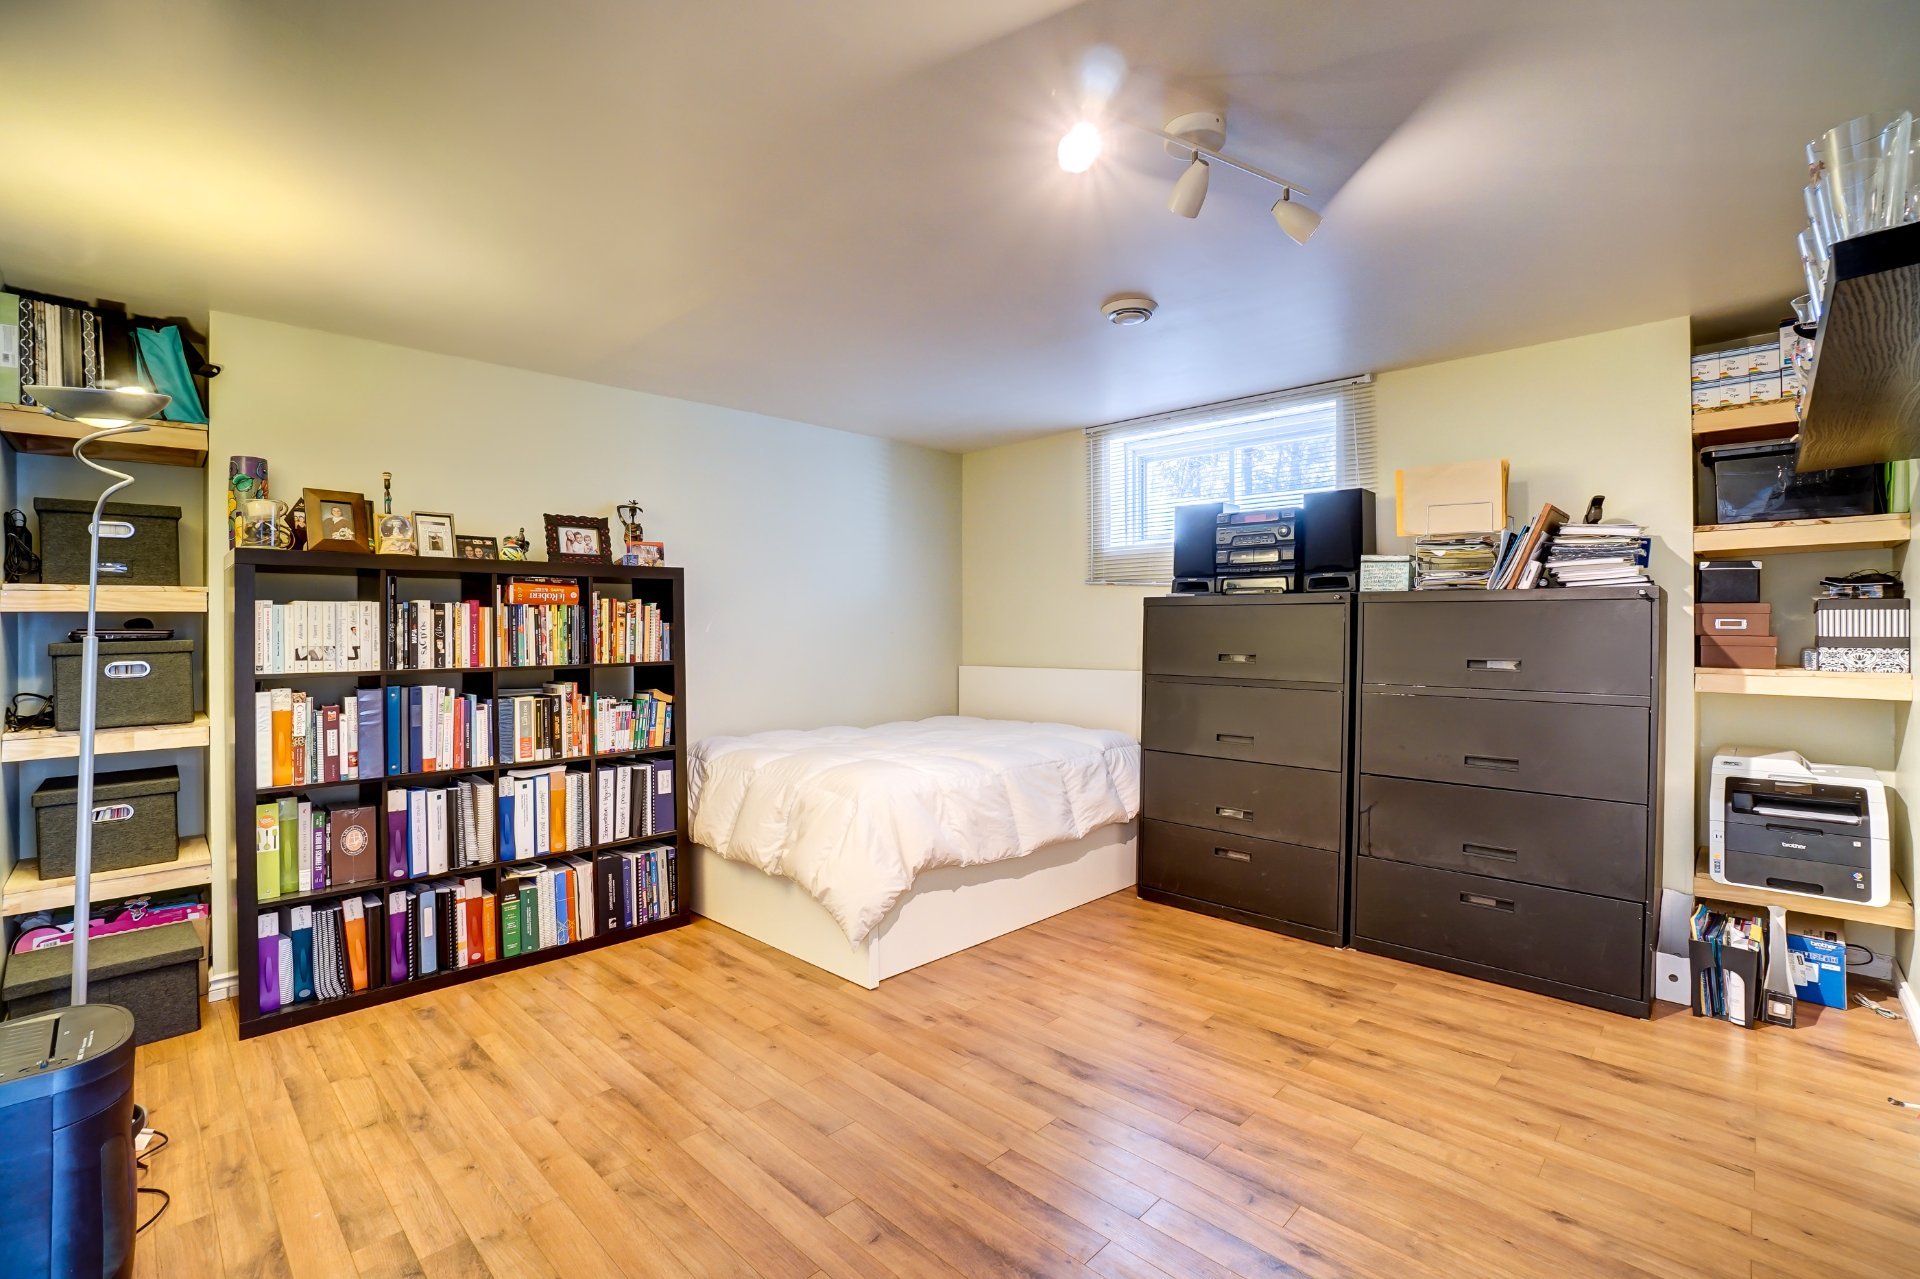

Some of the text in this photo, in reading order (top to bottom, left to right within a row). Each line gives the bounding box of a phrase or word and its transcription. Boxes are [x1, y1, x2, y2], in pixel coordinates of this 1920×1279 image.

[296, 704, 305, 735] Cookies
[1781, 842, 1807, 850] brother
[1810, 940, 1838, 950] brother
